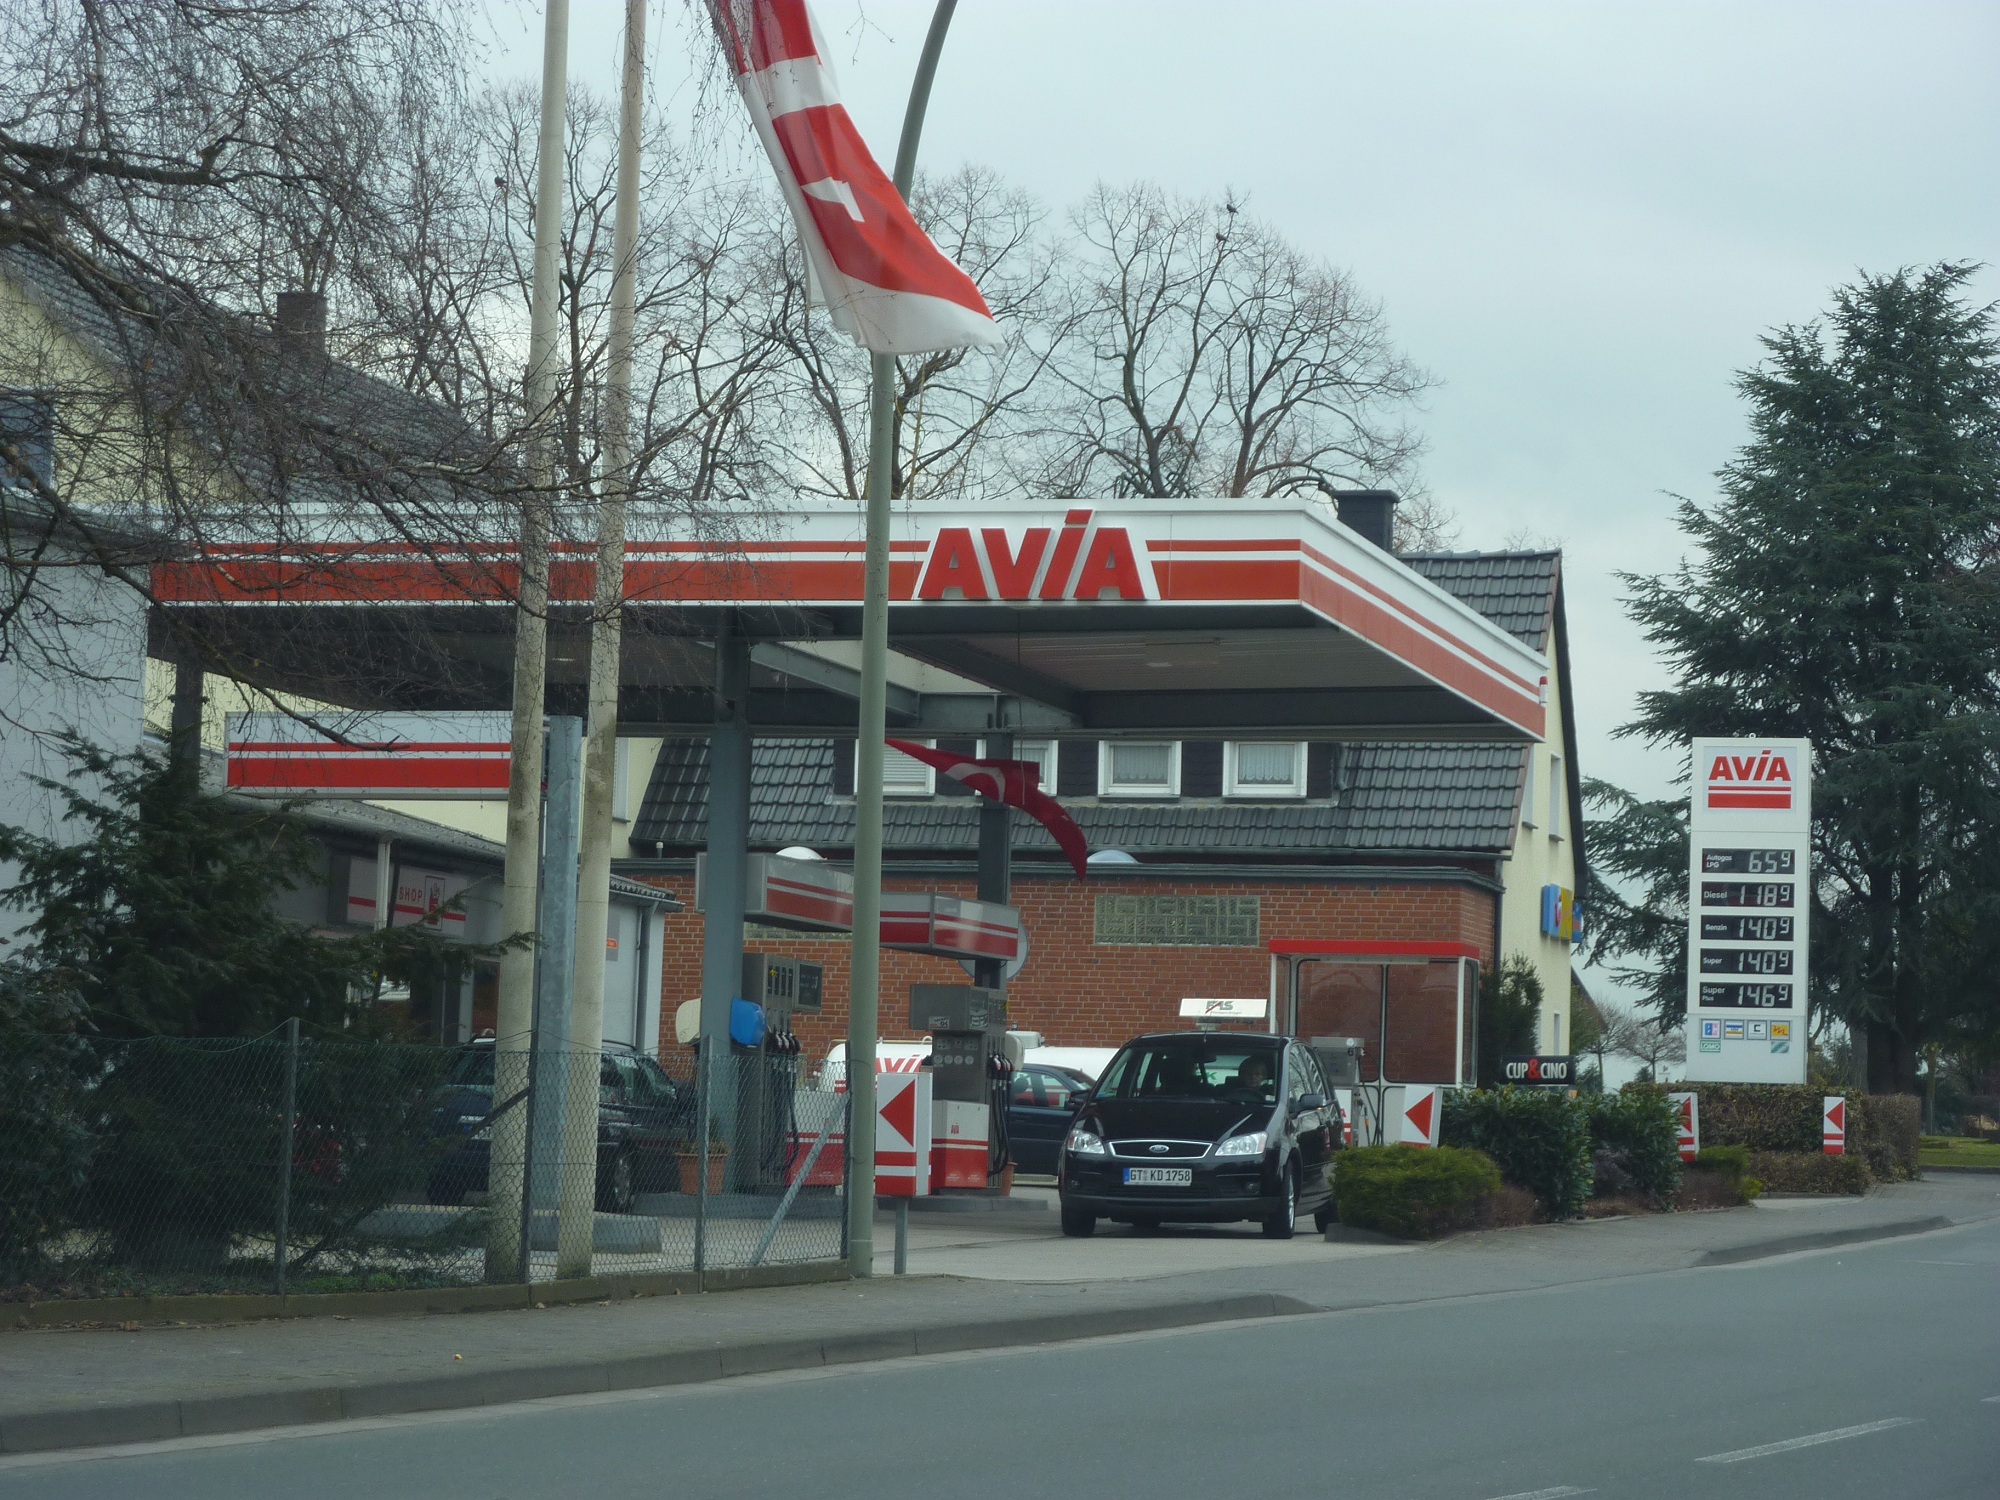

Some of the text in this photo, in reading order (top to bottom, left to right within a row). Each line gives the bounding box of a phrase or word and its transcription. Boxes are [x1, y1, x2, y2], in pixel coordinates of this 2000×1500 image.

[1706, 854, 1733, 863] Autogas
[398, 886, 423, 902] SHOP
[1703, 891, 1728, 899] Diesel
[1705, 923, 1728, 931] Benzin
[1703, 957, 1723, 966] Super
[1702, 986, 1726, 995] Super
[1130, 1169, 1191, 1182] GT KD 1758
